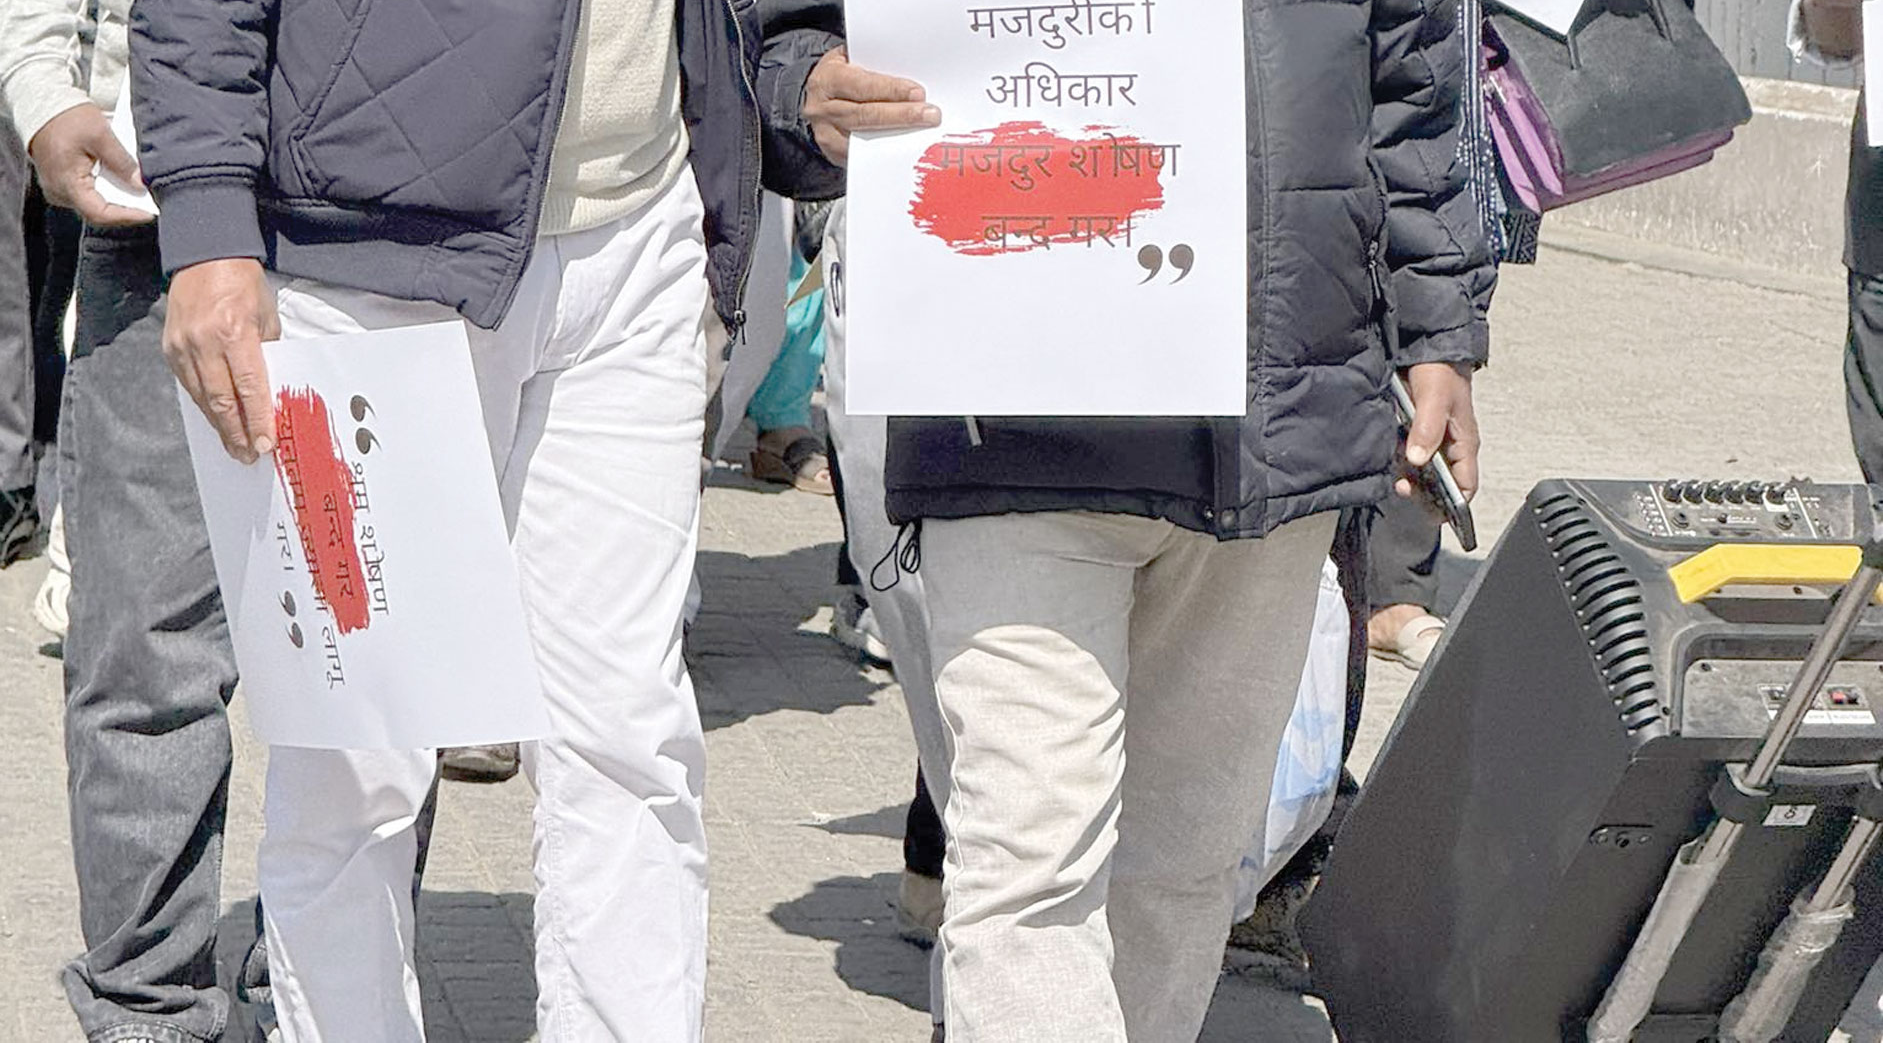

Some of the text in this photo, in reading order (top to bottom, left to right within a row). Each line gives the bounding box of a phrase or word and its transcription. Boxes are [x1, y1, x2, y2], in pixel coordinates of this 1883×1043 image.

[985, 62, 1138, 108] अधिकार
[938, 144, 1056, 191] मजदुर
[981, 215, 1055, 250] बन्द
[323, 492, 346, 549] बन्द
